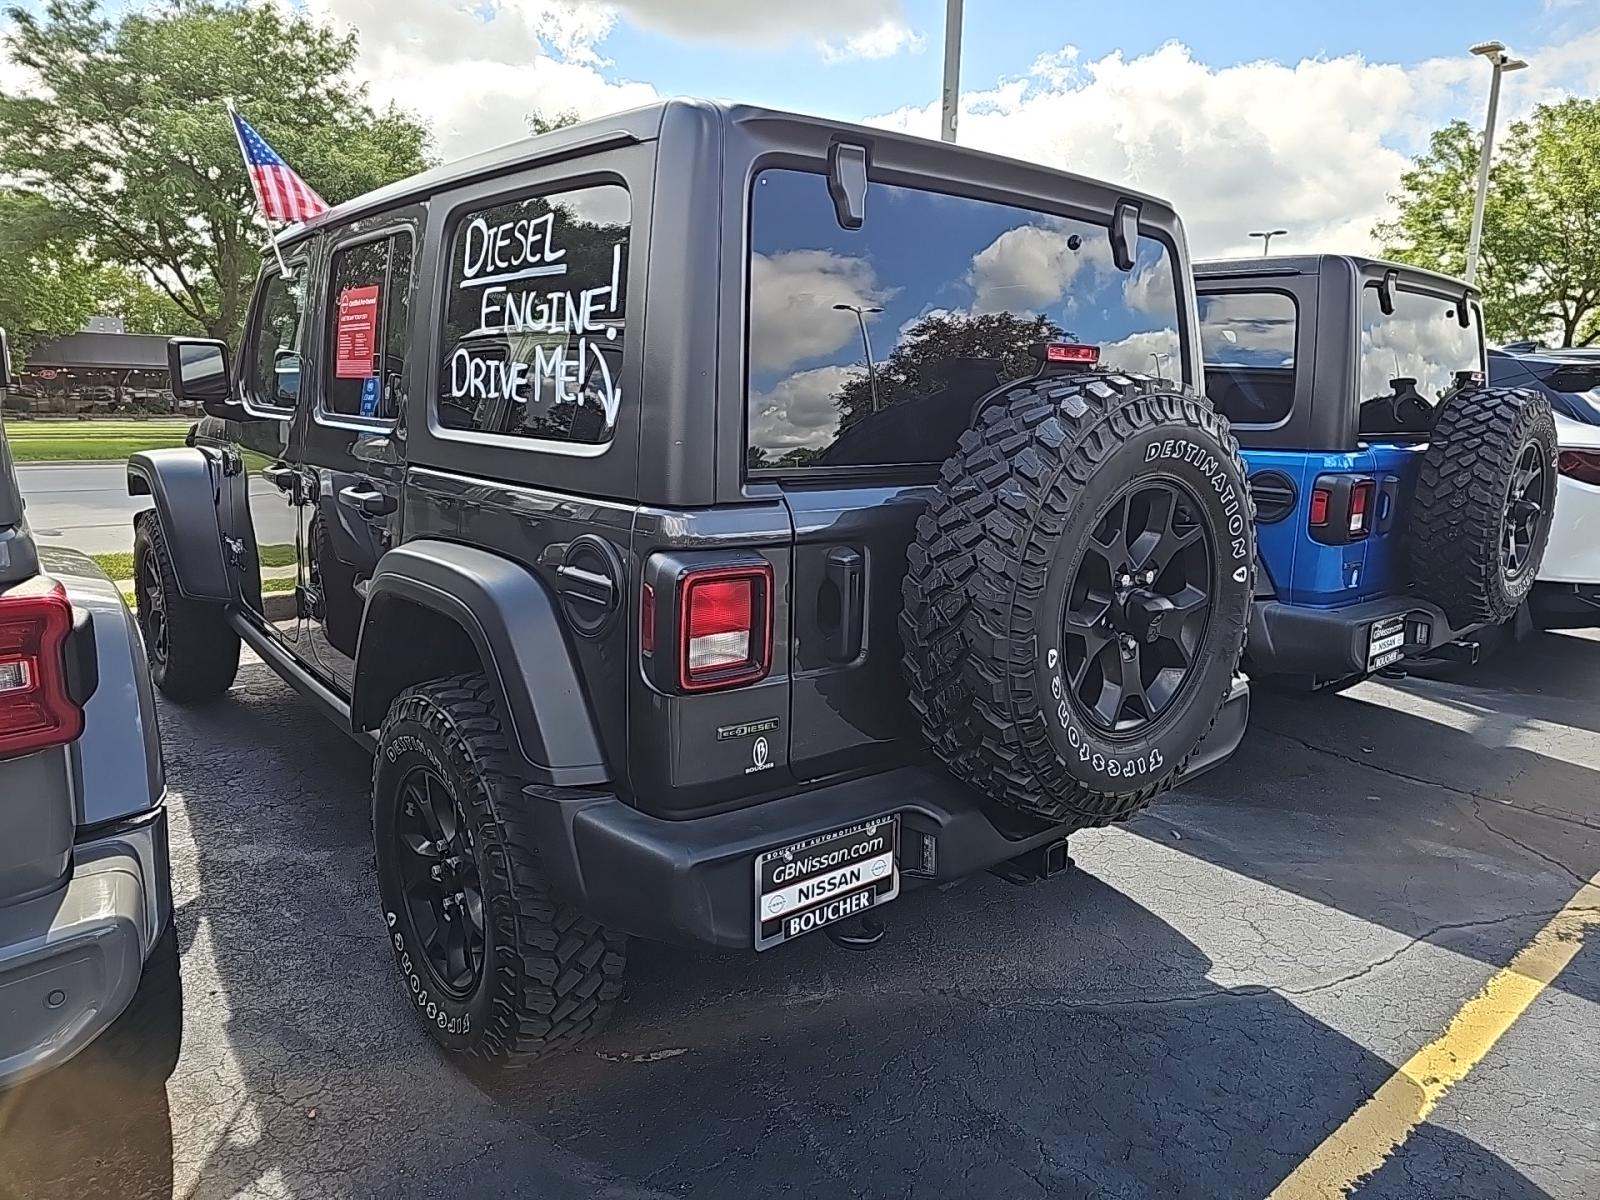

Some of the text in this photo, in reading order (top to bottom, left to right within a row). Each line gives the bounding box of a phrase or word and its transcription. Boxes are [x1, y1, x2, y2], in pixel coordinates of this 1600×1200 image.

[464, 213, 566, 278] DIESEL
[481, 244, 621, 340] ENGINE!
[451, 337, 586, 406] DRIVE ME!
[1145, 439, 1247, 559] DESTINATION
[745, 762, 774, 774] BOUCHER
[810, 825, 862, 845] AUTOMOTIVE
[865, 815, 891, 828] GROUP
[772, 836, 883, 883] GBNissan.com
[797, 868, 861, 903] NISSAN
[790, 891, 869, 936] BOUCHER
